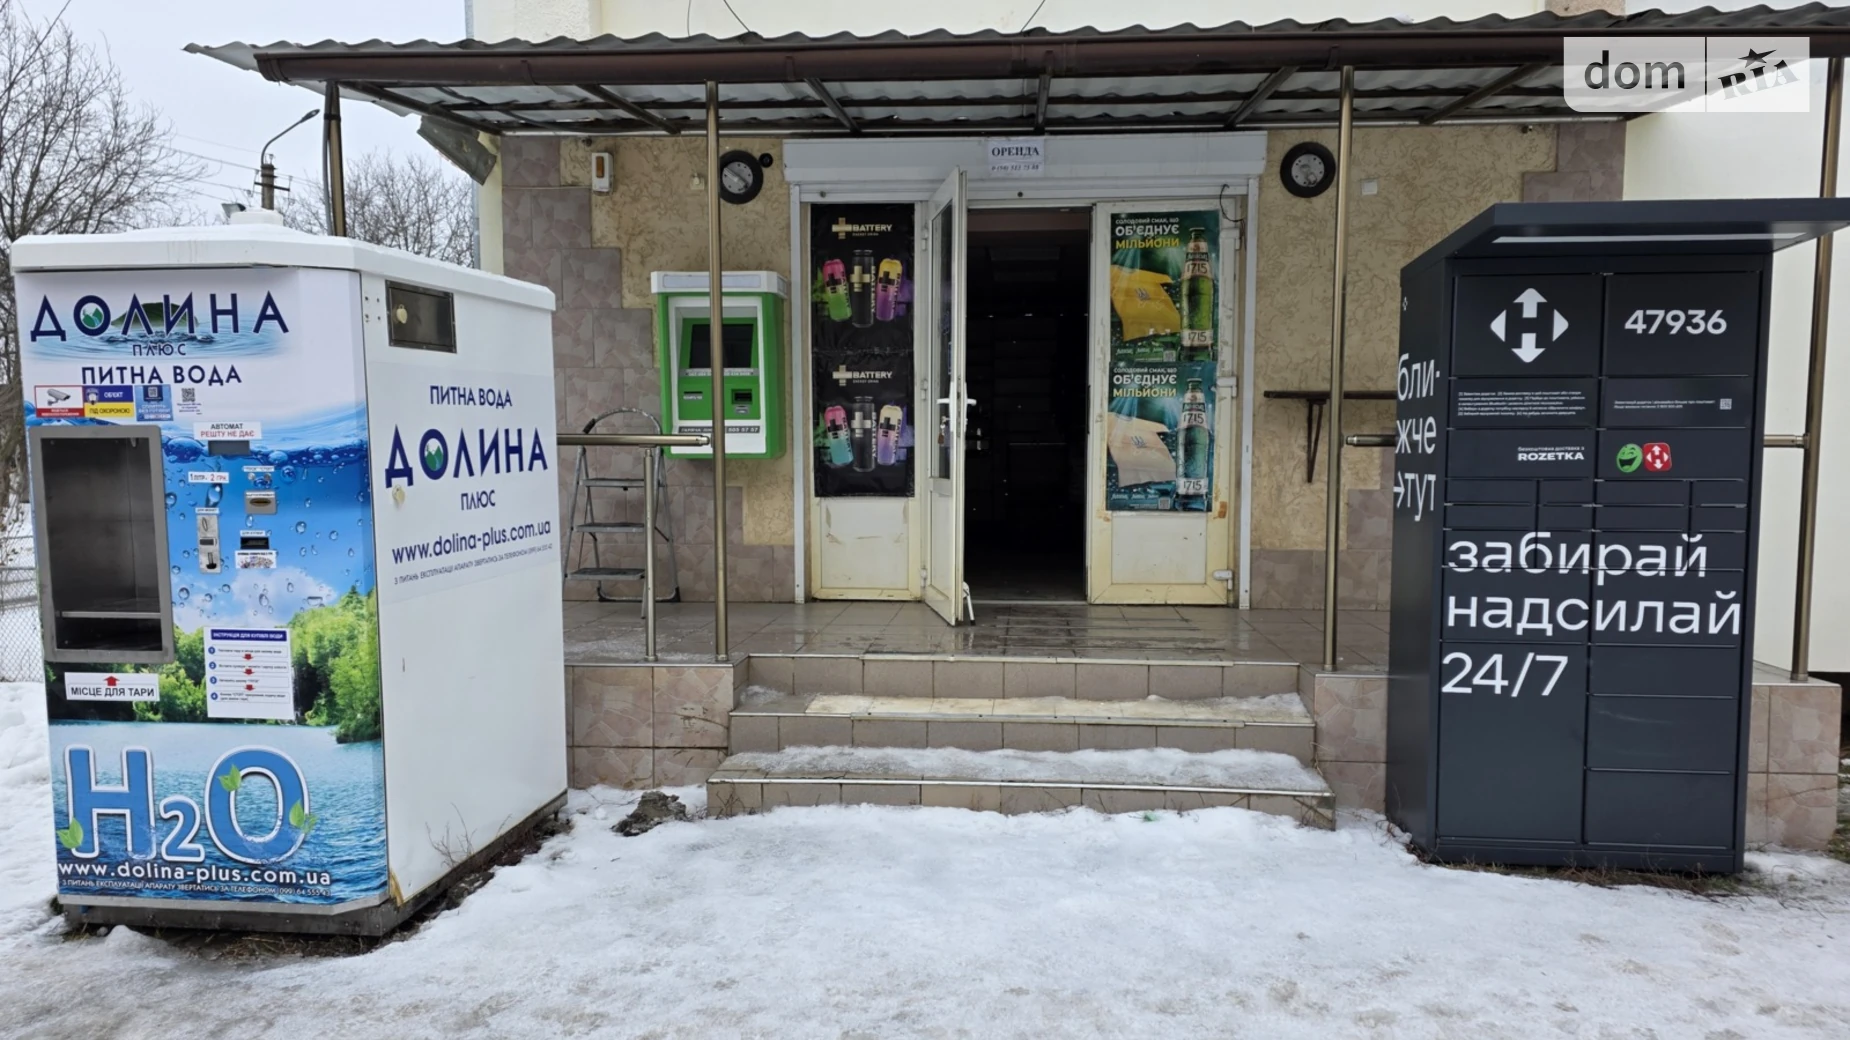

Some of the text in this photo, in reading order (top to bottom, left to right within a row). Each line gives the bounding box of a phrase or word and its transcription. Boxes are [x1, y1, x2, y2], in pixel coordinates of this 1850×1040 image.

[991, 146, 1040, 157] ОРЕНДА
[852, 224, 893, 232] BATTERY
[1115, 224, 1180, 237] ОБ'ЄДНУЄ
[1115, 236, 1180, 249] МІЛЬЙОНИ
[1187, 262, 1208, 275] 1715
[30, 290, 290, 342] ДОЛИНА
[1624, 309, 1728, 335] 47936
[1188, 332, 1207, 342] 1715
[132, 342, 187, 356] ПЛЮС
[81, 364, 243, 386] ПИТНА ВОДА
[852, 371, 893, 379] BATTERY
[1113, 374, 1178, 386] ОБ'ЄДНУЄ
[430, 385, 513, 409] ПИТНА ВОДА
[1113, 386, 1177, 398] МІЛЬЙОНИ
[1184, 412, 1204, 424] 1715
[1395, 416, 1437, 454] жче
[385, 424, 548, 489] ДОЛИНА
[1518, 452, 1585, 461] ROZETKA
[1184, 480, 1202, 491] 1715
[460, 489, 496, 511] ПЛЮС
[1404, 472, 1437, 522] тут
[392, 521, 551, 564] www.dolina-plus.com.ua
[1448, 532, 1707, 586] забирай
[1447, 590, 1742, 636] надсилай
[1441, 652, 1568, 698] 24/7
[70, 687, 154, 697] МІСЦЕ ДЛЯ ТАРИ
[64, 743, 310, 865] H2O
[57, 861, 331, 885] www.dolina-plus.com.ua
